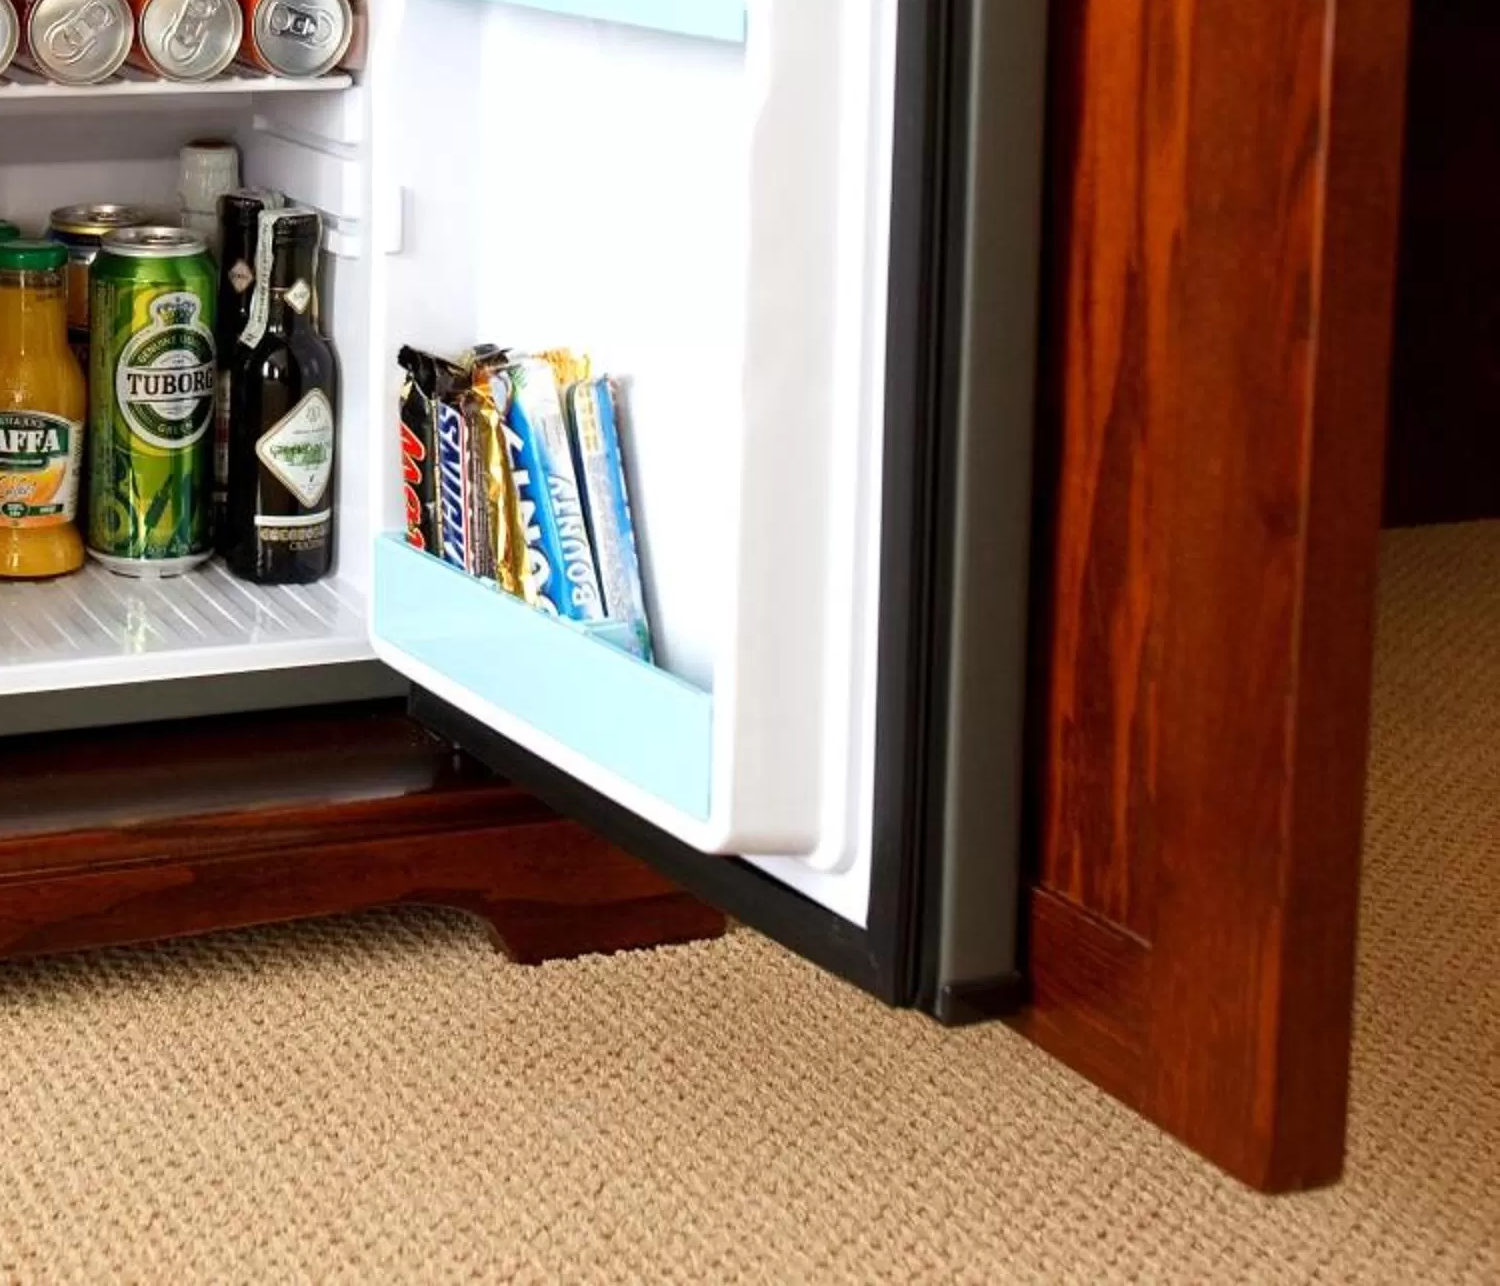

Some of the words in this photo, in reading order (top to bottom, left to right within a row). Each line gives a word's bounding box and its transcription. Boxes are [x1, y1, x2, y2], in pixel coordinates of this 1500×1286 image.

[126, 367, 213, 396] TUBORG
[437, 402, 467, 571] SNICK
[548, 474, 596, 606] BOUNTY
